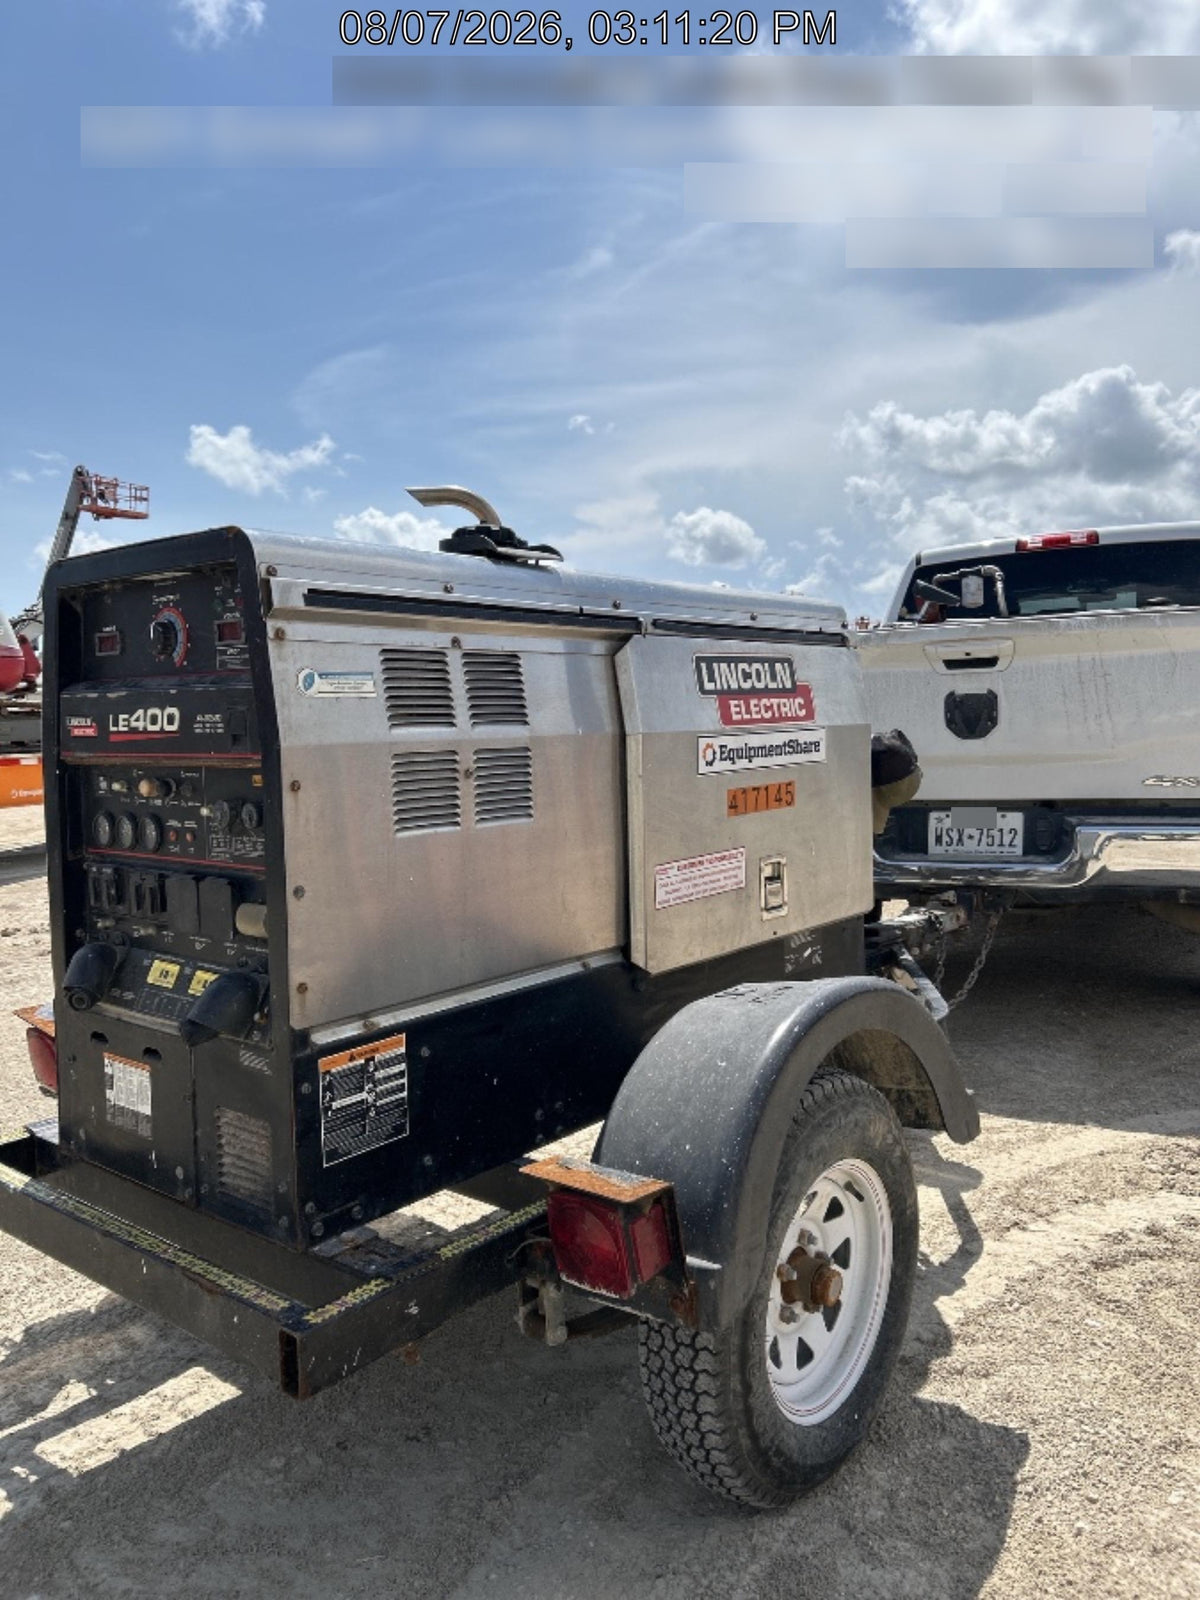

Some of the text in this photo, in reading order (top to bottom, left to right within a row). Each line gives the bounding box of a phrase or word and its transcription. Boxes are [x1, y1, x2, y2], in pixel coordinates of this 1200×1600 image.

[700, 662, 792, 691] LINCOLN
[109, 705, 181, 732] LE400
[728, 697, 807, 721] ELECTRIC
[719, 738, 821, 765] EquipmentShare
[728, 781, 795, 814] 417145
